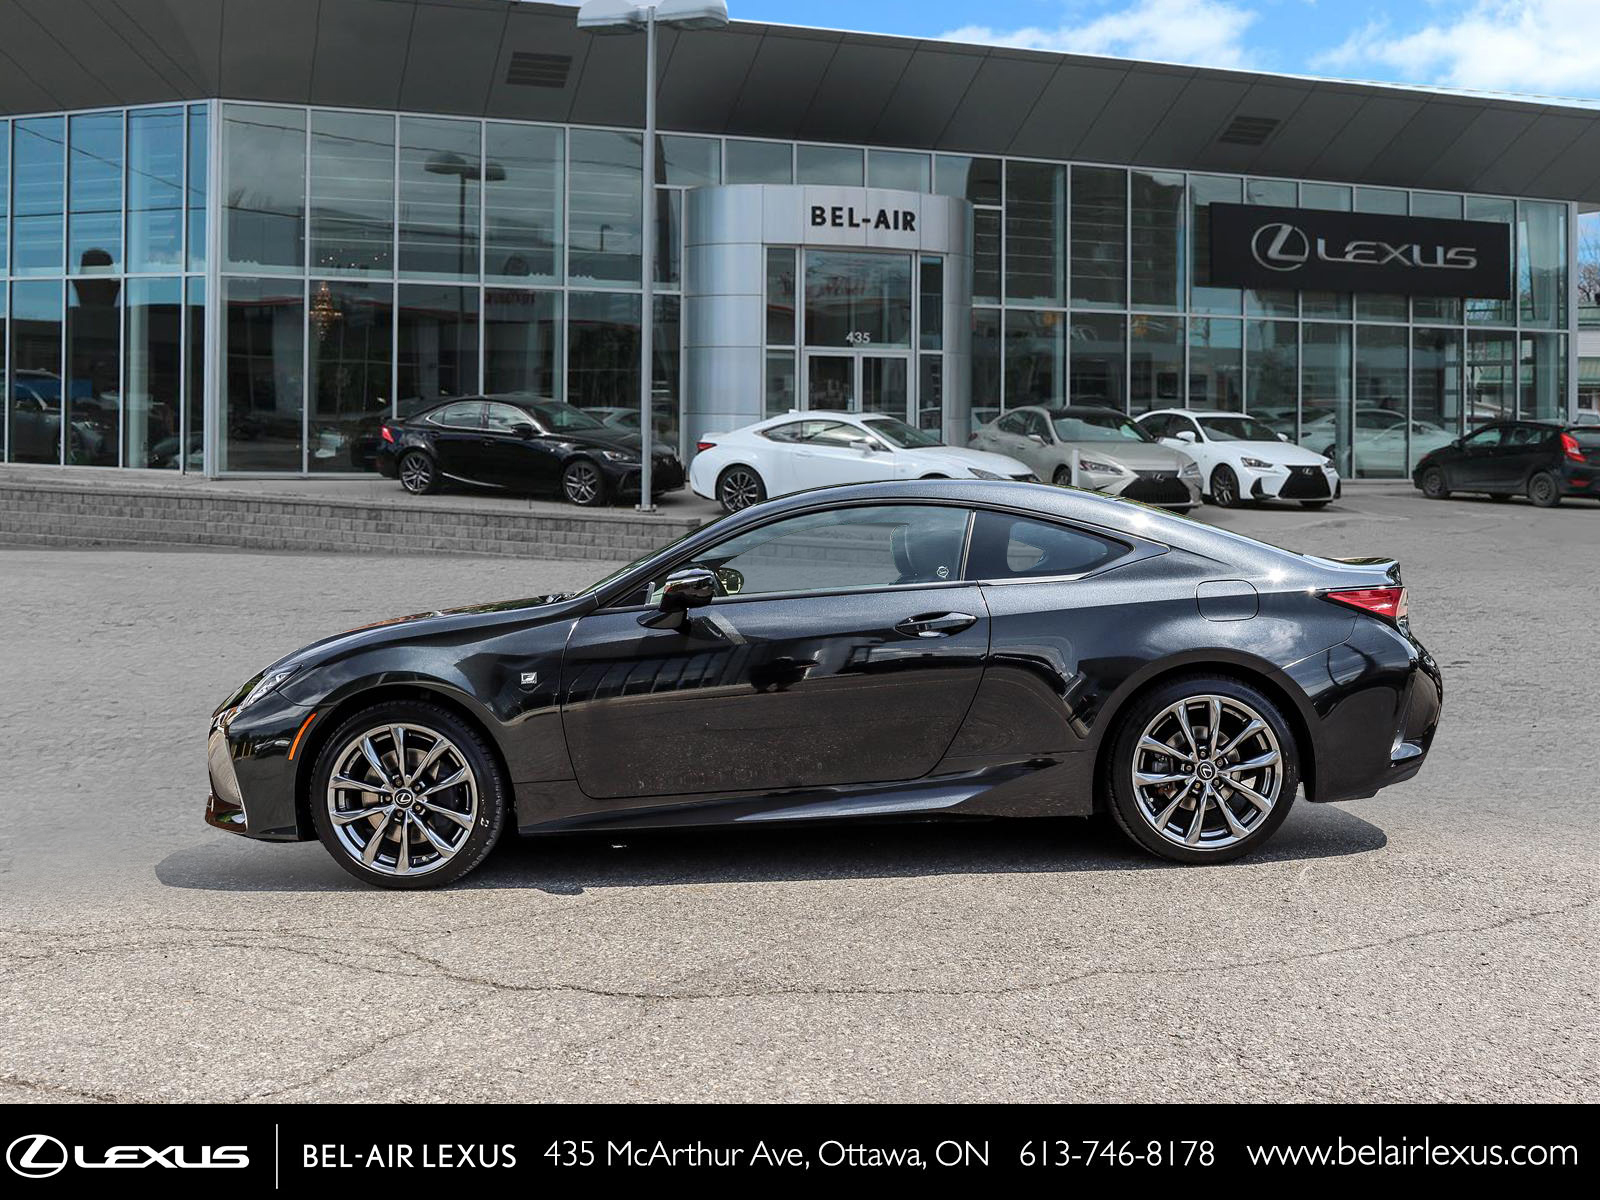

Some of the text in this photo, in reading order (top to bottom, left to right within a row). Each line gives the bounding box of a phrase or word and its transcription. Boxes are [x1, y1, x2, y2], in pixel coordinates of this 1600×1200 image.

[811, 205, 916, 232] BEL-AIR
[1317, 238, 1478, 269] LEXUS
[845, 331, 871, 344] 435
